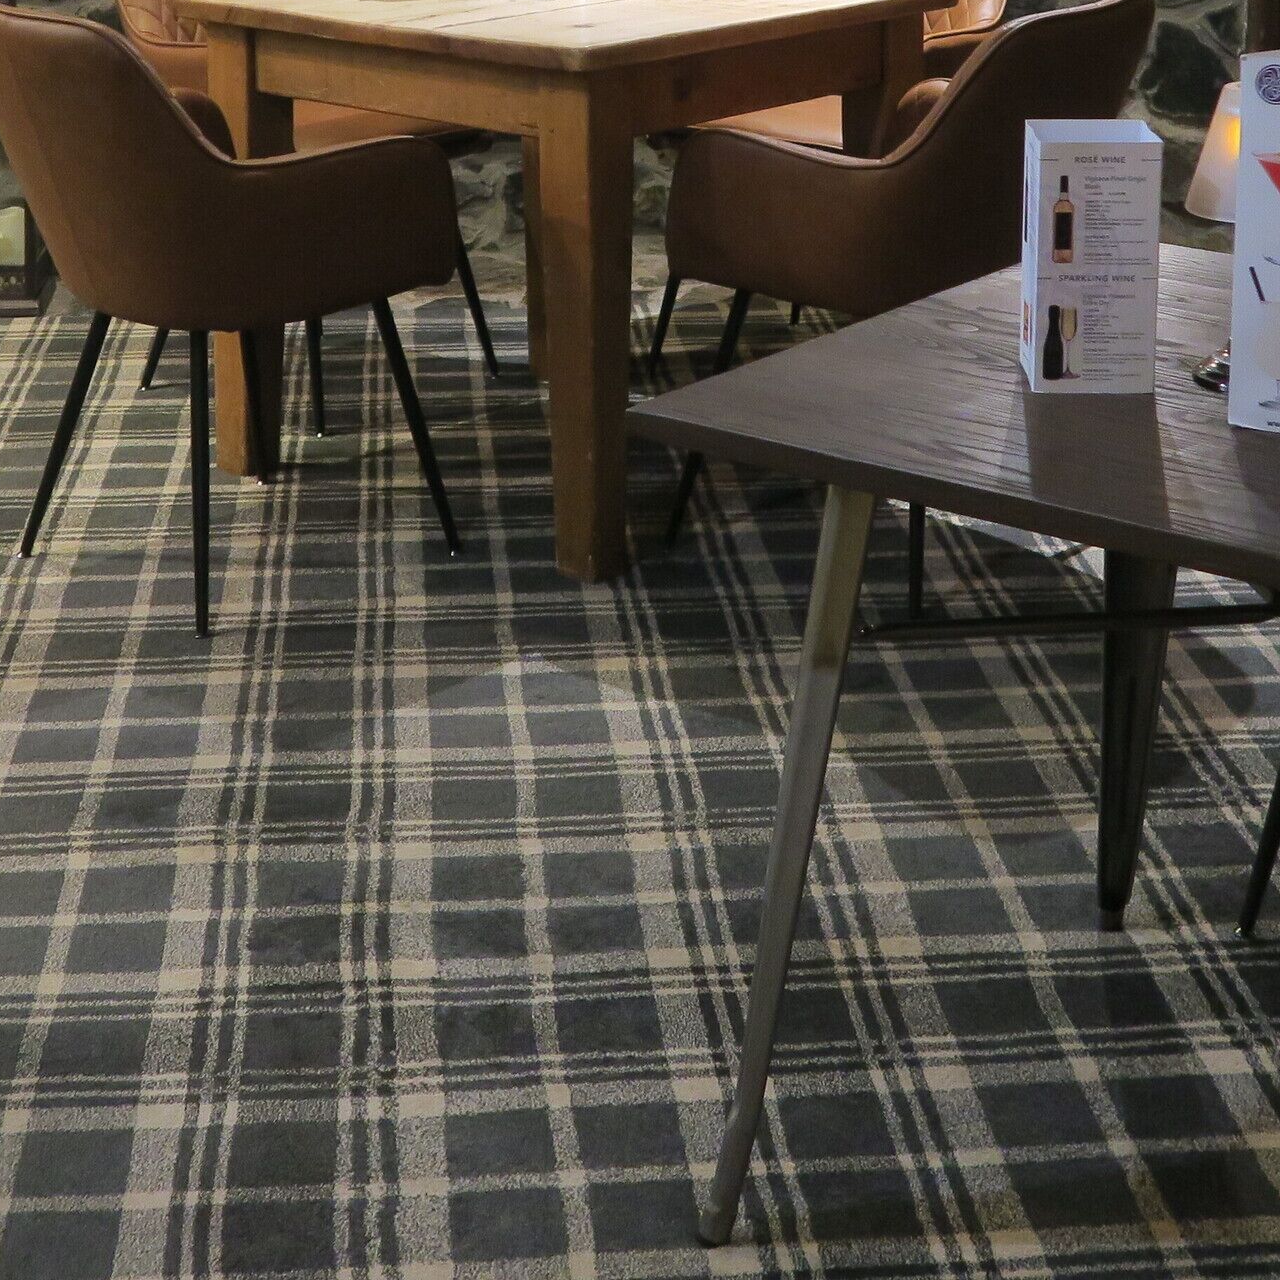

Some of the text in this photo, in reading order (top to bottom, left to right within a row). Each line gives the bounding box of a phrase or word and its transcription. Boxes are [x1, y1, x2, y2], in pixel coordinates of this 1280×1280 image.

[1101, 156, 1127, 164] WINE
[1058, 274, 1136, 283] SPARKLING WINE
